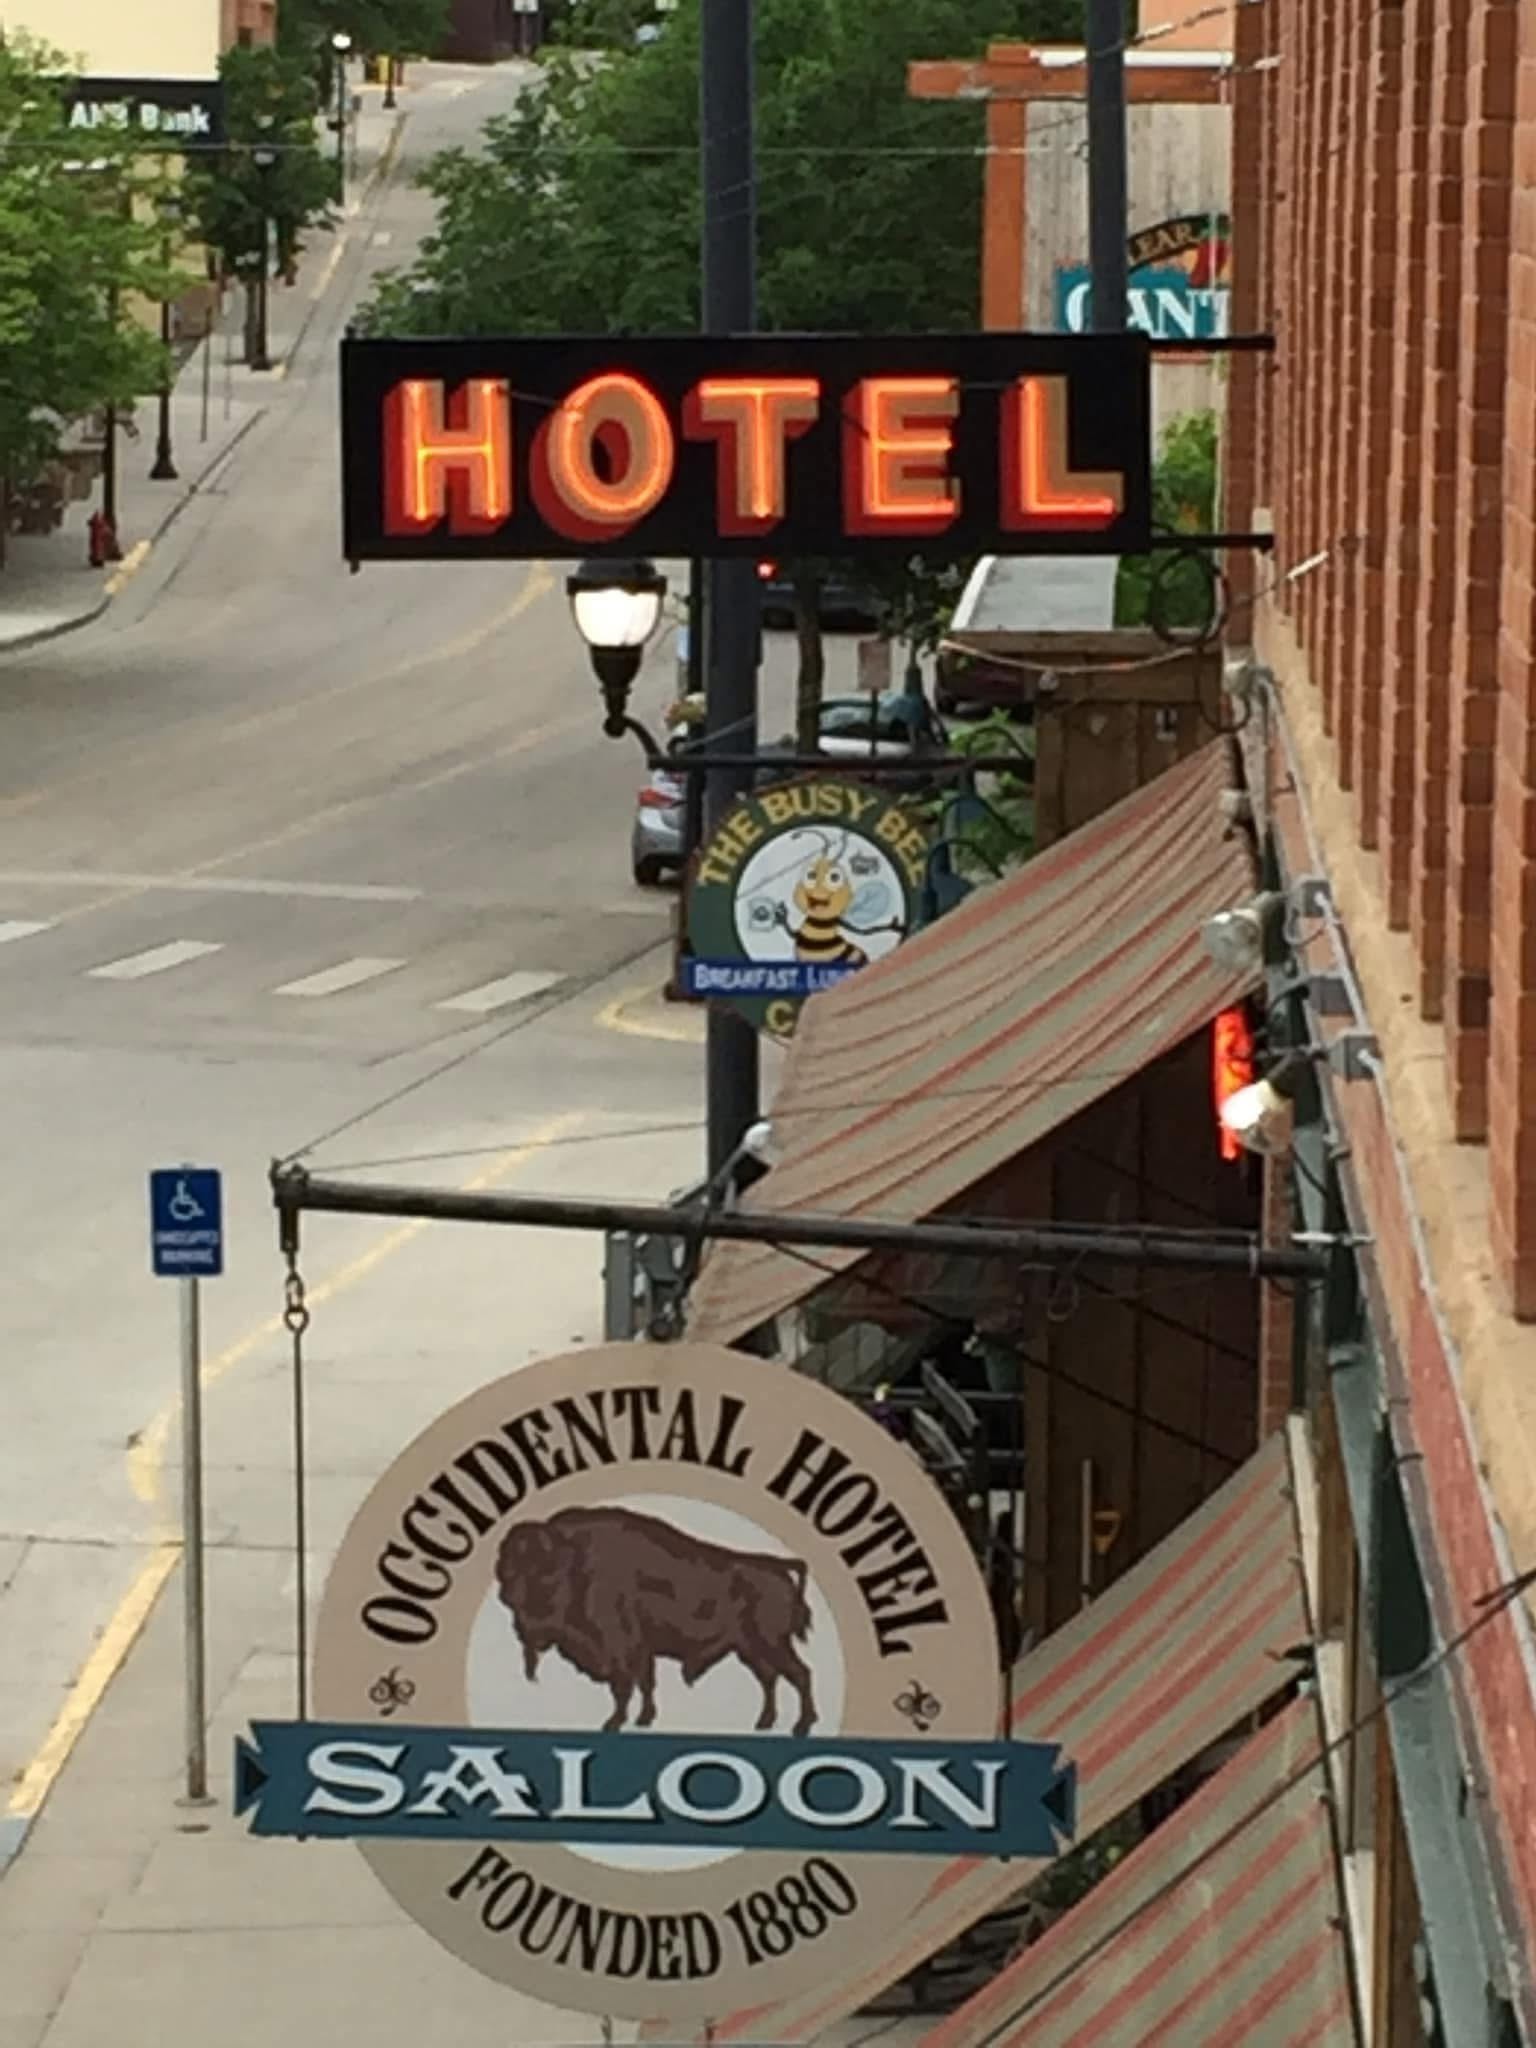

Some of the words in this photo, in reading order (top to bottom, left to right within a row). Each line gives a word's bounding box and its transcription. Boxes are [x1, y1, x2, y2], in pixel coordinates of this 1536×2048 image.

[1128, 222, 1196, 266] EAR
[1066, 282, 1231, 338] CANT
[386, 372, 1124, 540] HOTEL
[699, 810, 763, 885] THE
[758, 784, 877, 824] BUSY
[361, 1386, 752, 1645] OCCIDENTAL
[765, 1429, 949, 1658] HOTEL
[303, 1742, 1008, 1829] SALOON
[447, 1846, 722, 1981] FOUNDED
[725, 1857, 859, 1967] 1880
